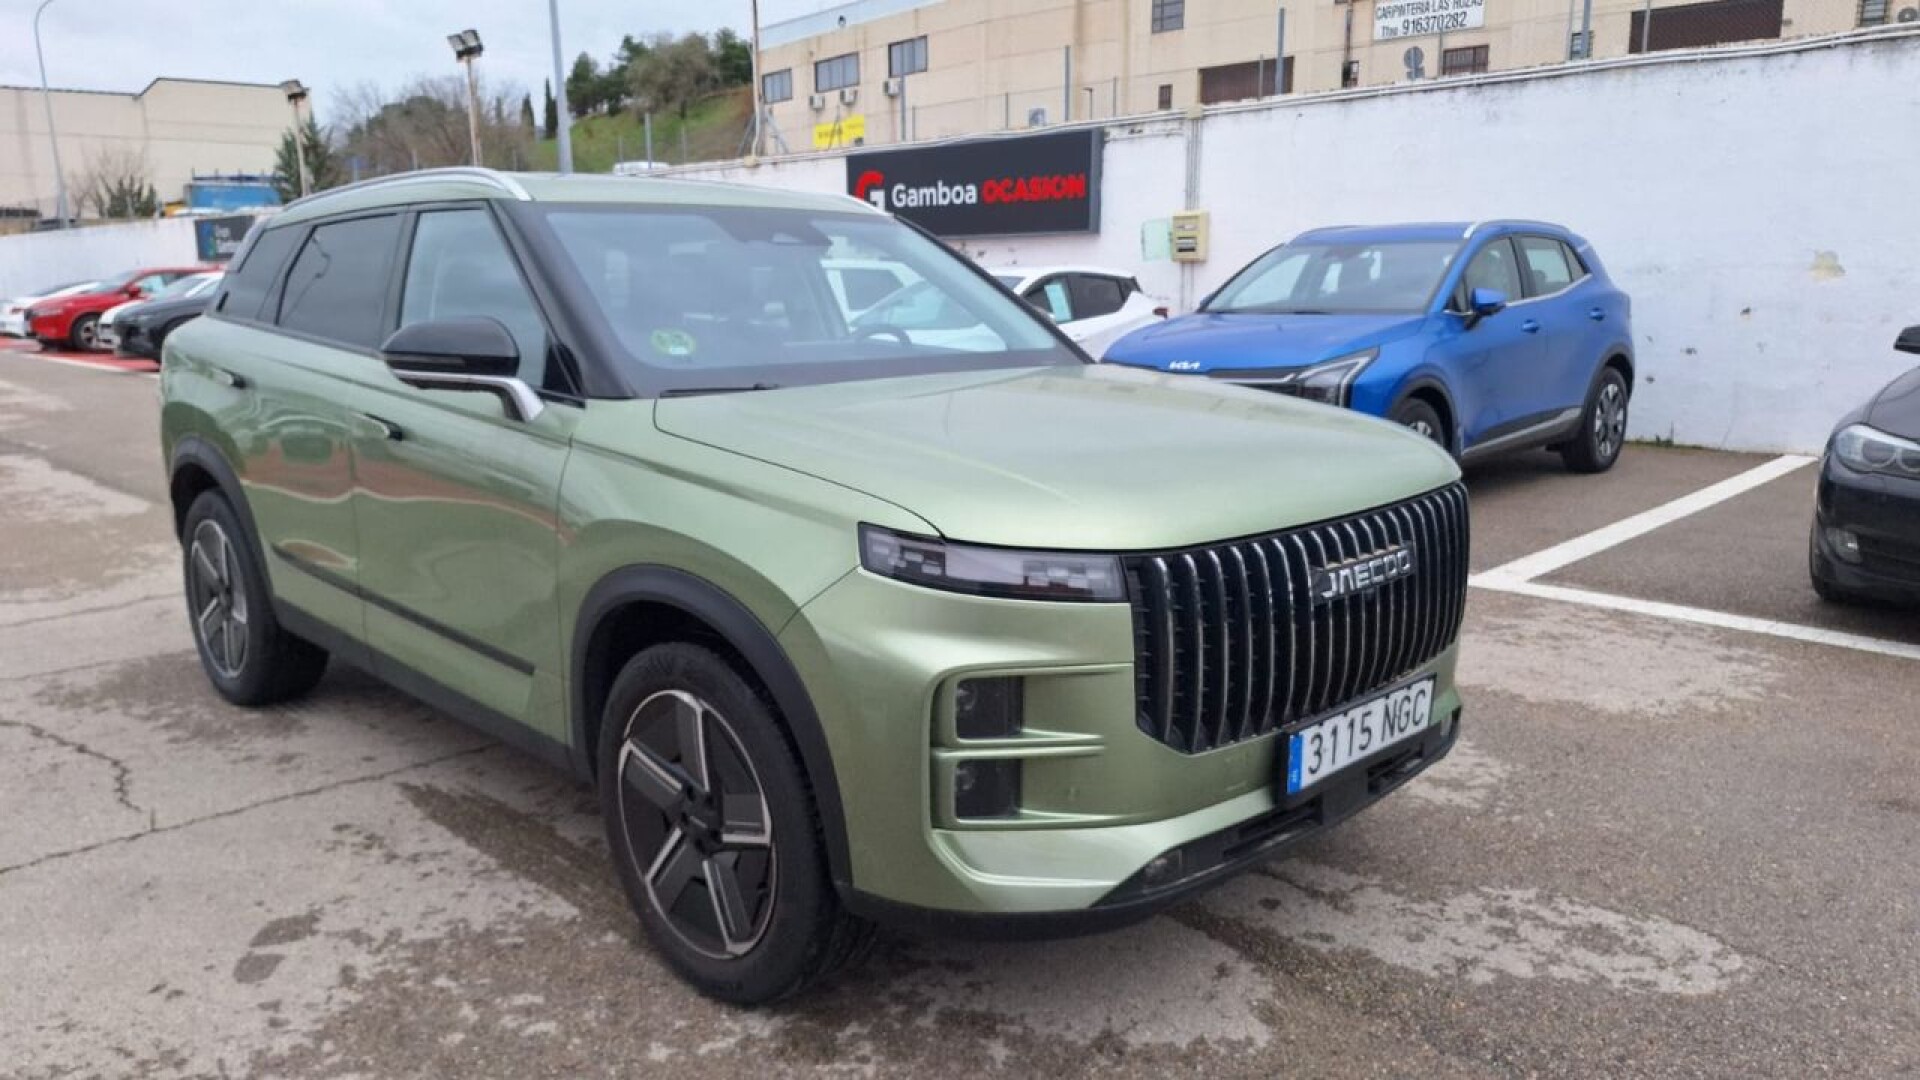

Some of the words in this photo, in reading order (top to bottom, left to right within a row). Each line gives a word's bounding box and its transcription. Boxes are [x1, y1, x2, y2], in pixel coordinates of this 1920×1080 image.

[1433, 0, 1450, 13] LAS
[1402, 11, 1467, 35] 916370282
[891, 180, 978, 208] Gamboa
[982, 174, 1086, 204] OCASION
[1308, 710, 1373, 775] 3115
[1381, 688, 1427, 743] NGC
